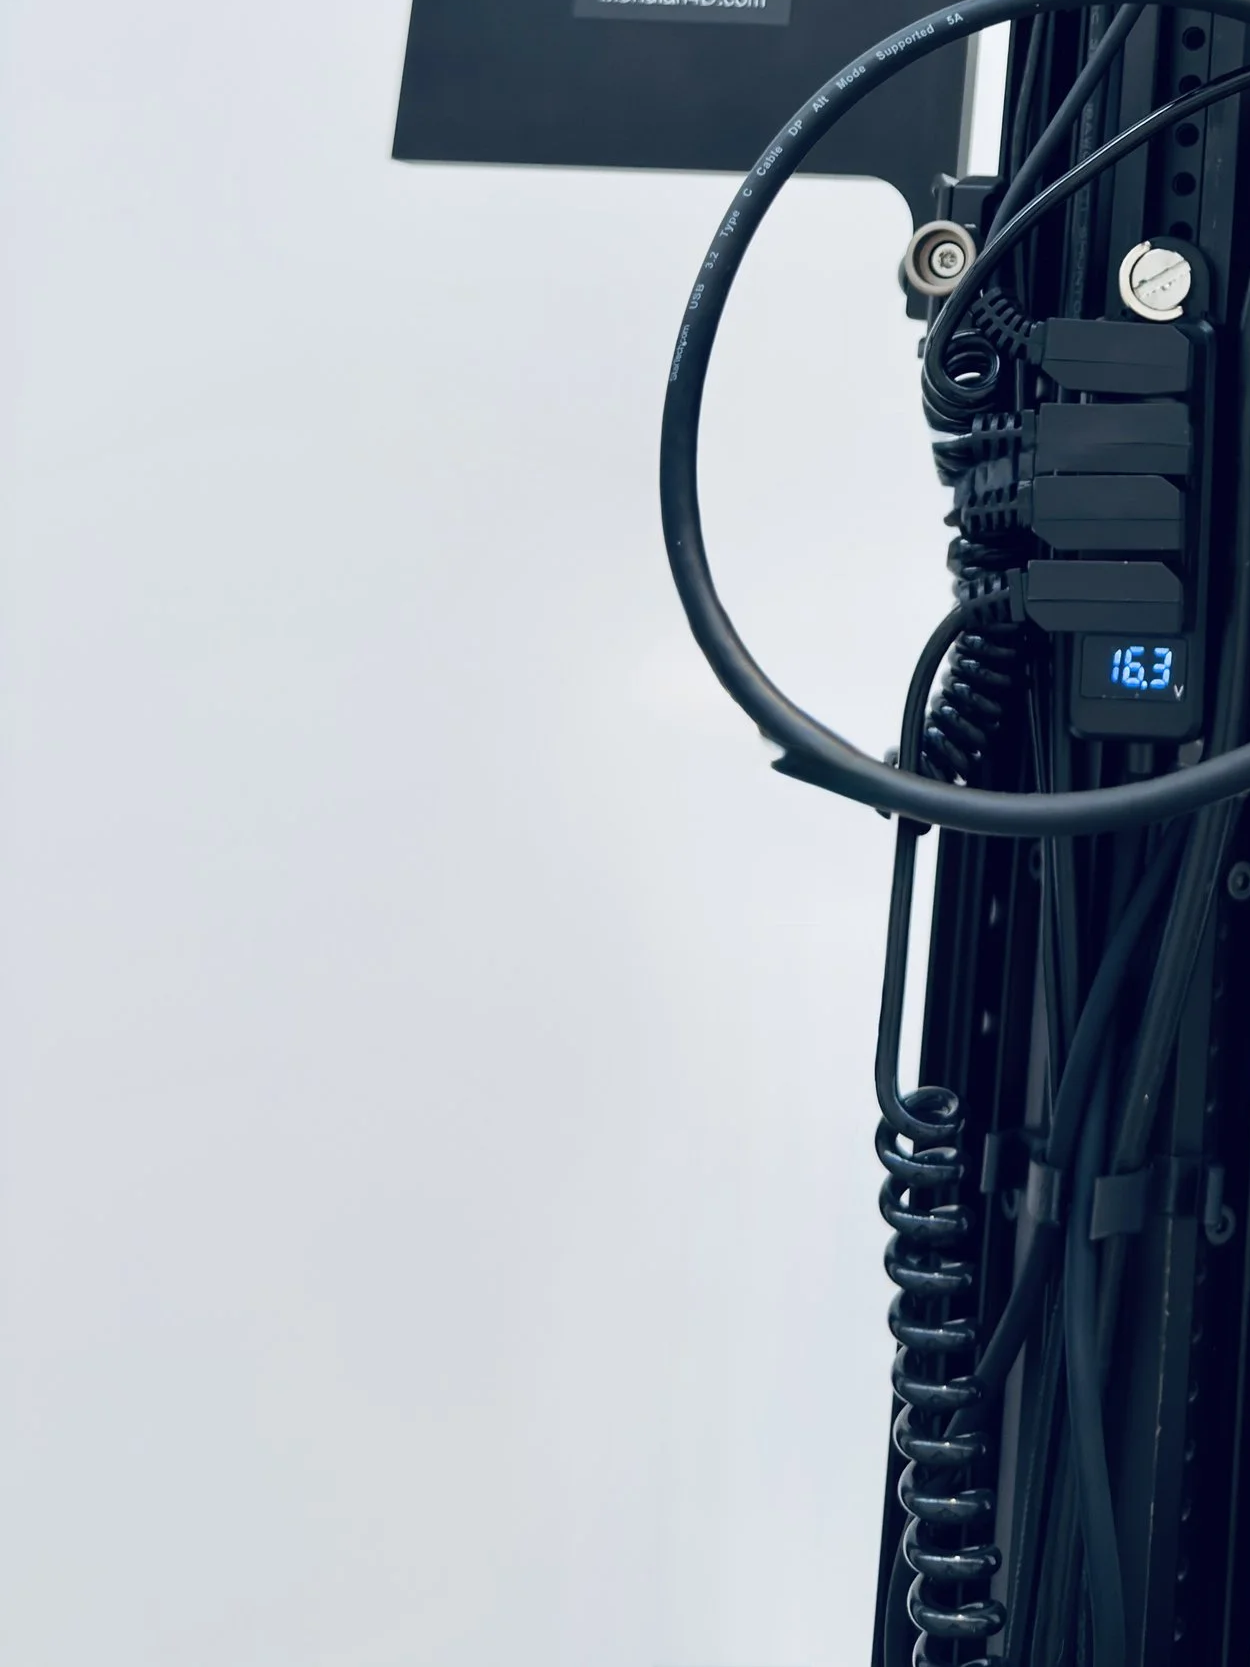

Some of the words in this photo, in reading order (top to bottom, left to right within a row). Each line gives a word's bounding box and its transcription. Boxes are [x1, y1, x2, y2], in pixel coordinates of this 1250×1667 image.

[689, 283, 705, 310] USB
[705, 251, 719, 269] 3.2
[719, 210, 740, 237] Type
[742, 188, 753, 197] C
[756, 146, 783, 176] Cable
[788, 119, 803, 137] DP
[812, 95, 829, 113] Alt
[835, 65, 866, 90] Mode
[875, 24, 935, 61] Supported
[946, 13, 964, 25] 5A
[1110, 645, 1173, 691] 16.3
